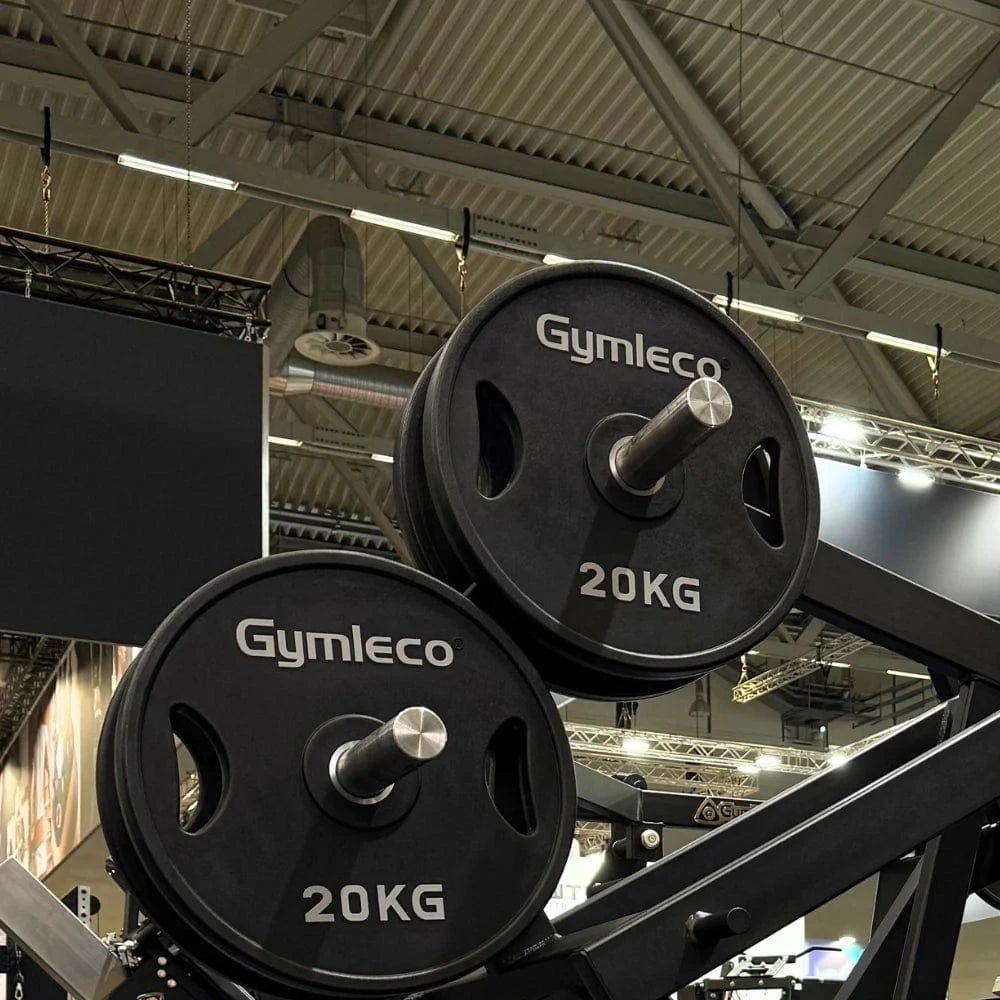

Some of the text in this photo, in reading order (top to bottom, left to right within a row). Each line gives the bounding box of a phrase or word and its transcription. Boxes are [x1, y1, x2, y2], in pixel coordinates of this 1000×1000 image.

[536, 313, 722, 382] Gymleco
[579, 562, 701, 612] 20KG
[235, 618, 454, 668] Gymleco
[302, 884, 446, 922] 20KG
